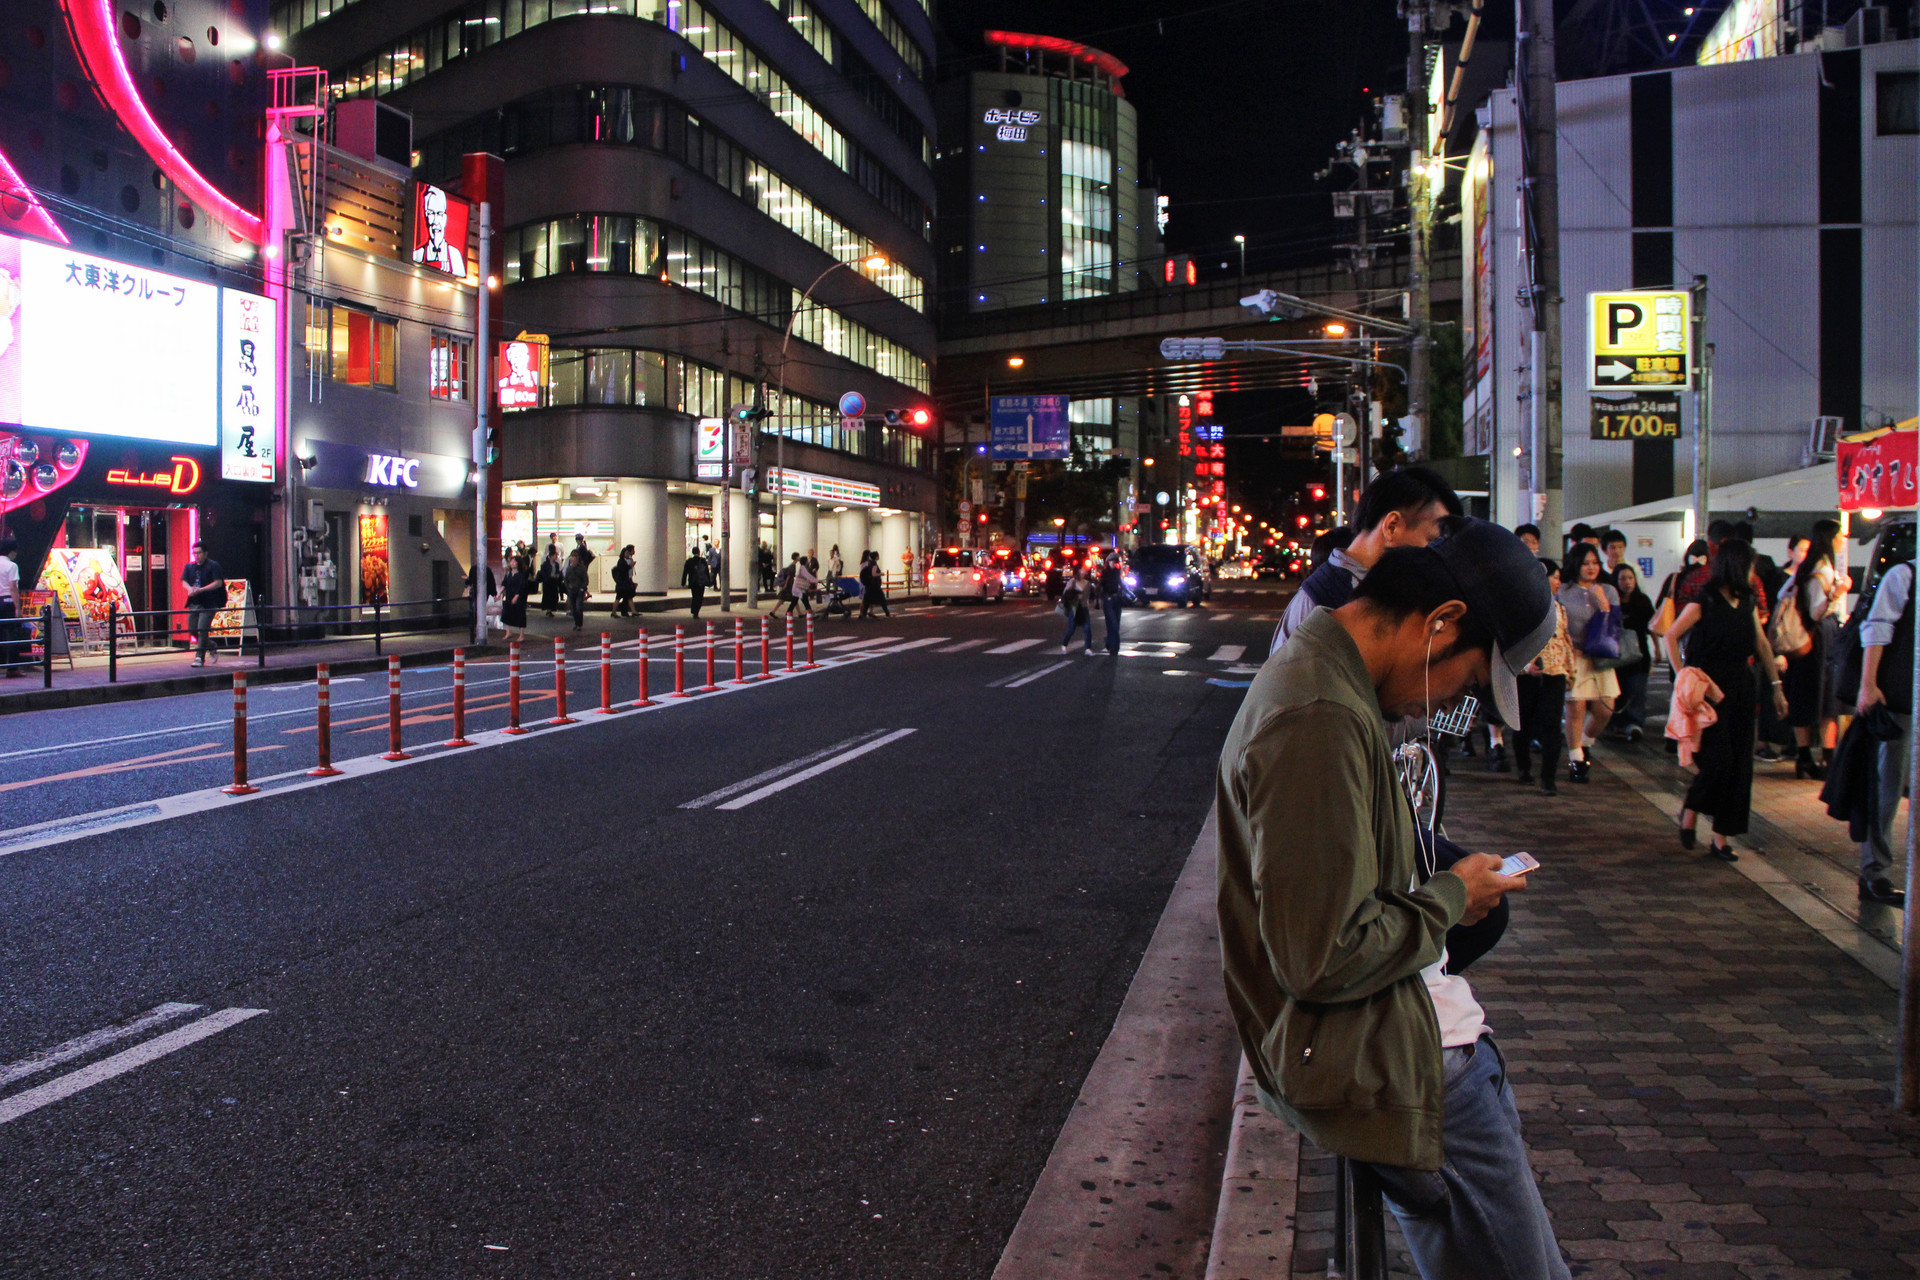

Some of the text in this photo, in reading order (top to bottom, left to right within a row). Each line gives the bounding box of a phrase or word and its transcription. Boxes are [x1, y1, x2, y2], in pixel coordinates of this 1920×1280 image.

[997, 125, 1027, 141] 梅田
[1608, 303, 1643, 345] P
[1599, 414, 1678, 438] 1,700円
[106, 456, 202, 495] CLUB D
[369, 453, 420, 488] KFC
